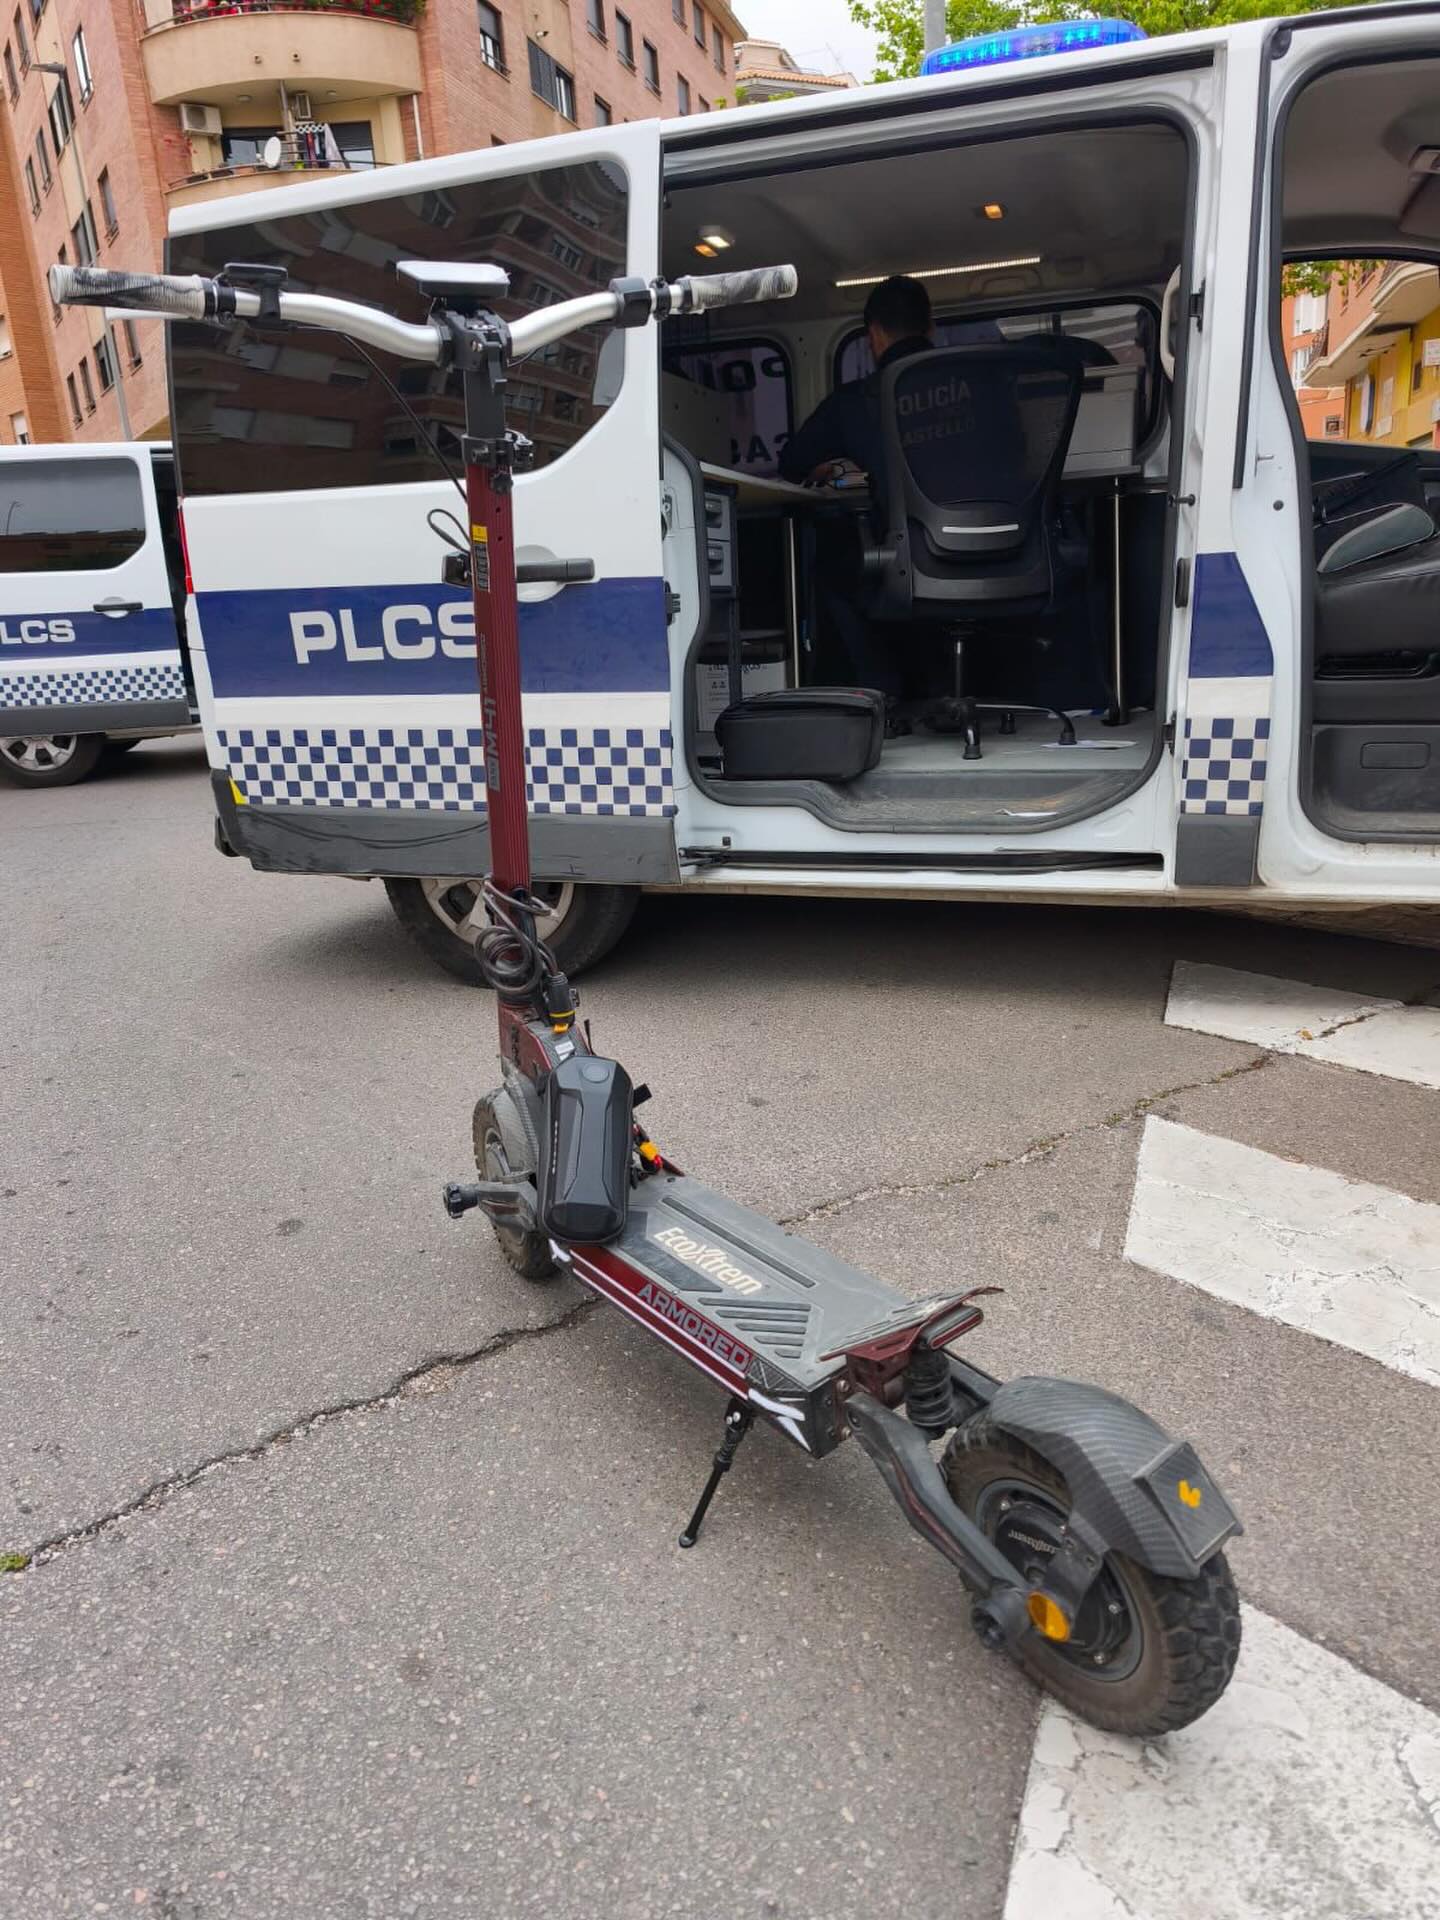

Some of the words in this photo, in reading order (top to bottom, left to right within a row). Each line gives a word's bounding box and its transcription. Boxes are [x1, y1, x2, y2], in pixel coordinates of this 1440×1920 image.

[896, 376, 972, 412] OLICÍA
[0, 619, 76, 645] LCS
[289, 601, 477, 664] PLCS
[654, 1227, 762, 1295] EcoXtrem
[638, 1284, 749, 1371] ARMORED
